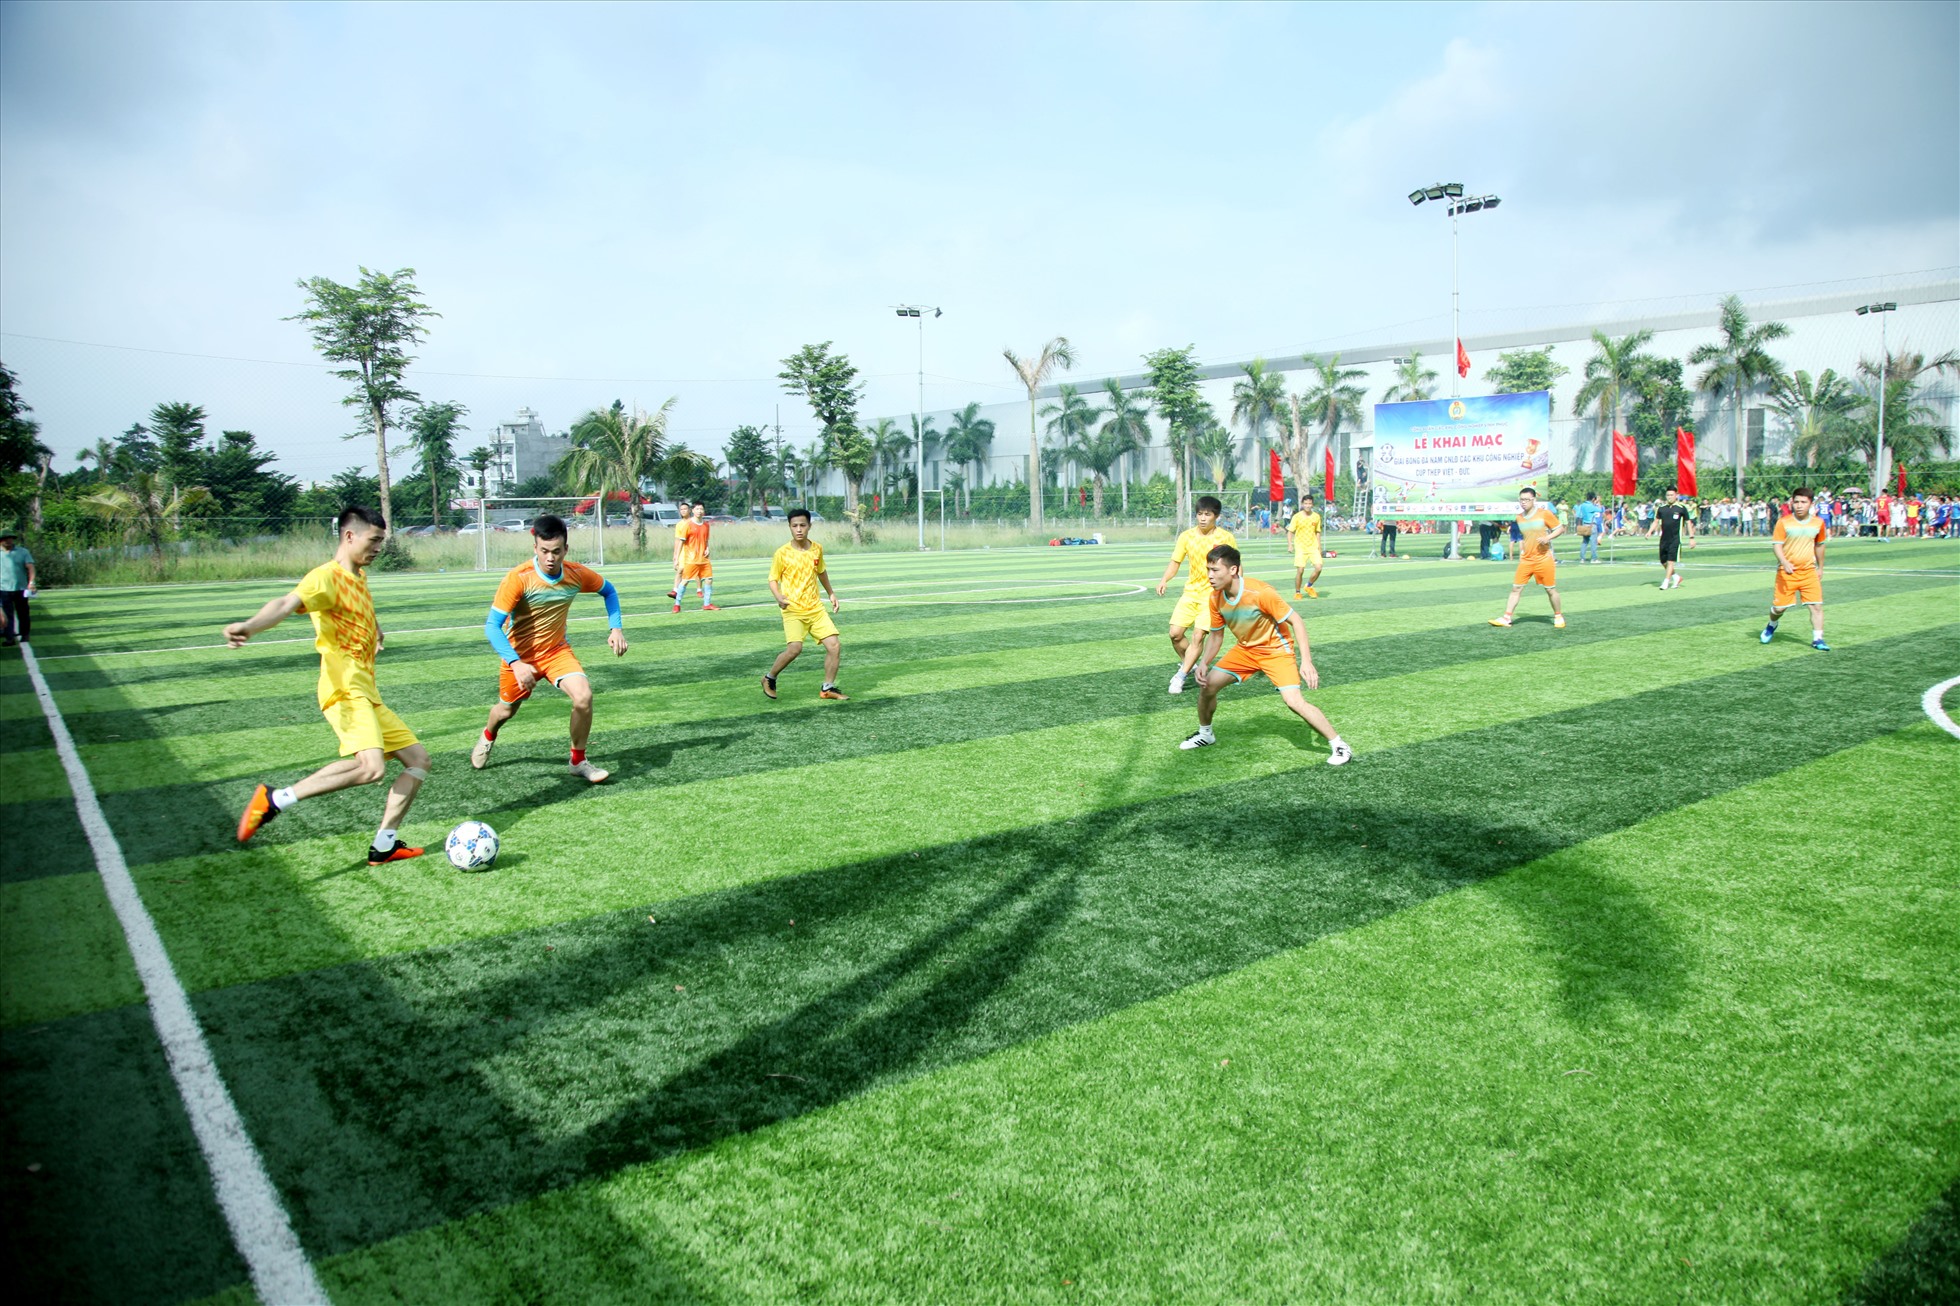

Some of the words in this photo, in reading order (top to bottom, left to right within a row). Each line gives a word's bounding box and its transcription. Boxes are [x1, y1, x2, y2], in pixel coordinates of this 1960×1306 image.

[1433, 435, 1466, 449] KHAI
[1471, 433, 1503, 449] MẠC
[1430, 456, 1443, 464] NAM
[1472, 454, 1484, 463] KHU
[1879, 500, 1885, 509] 9
